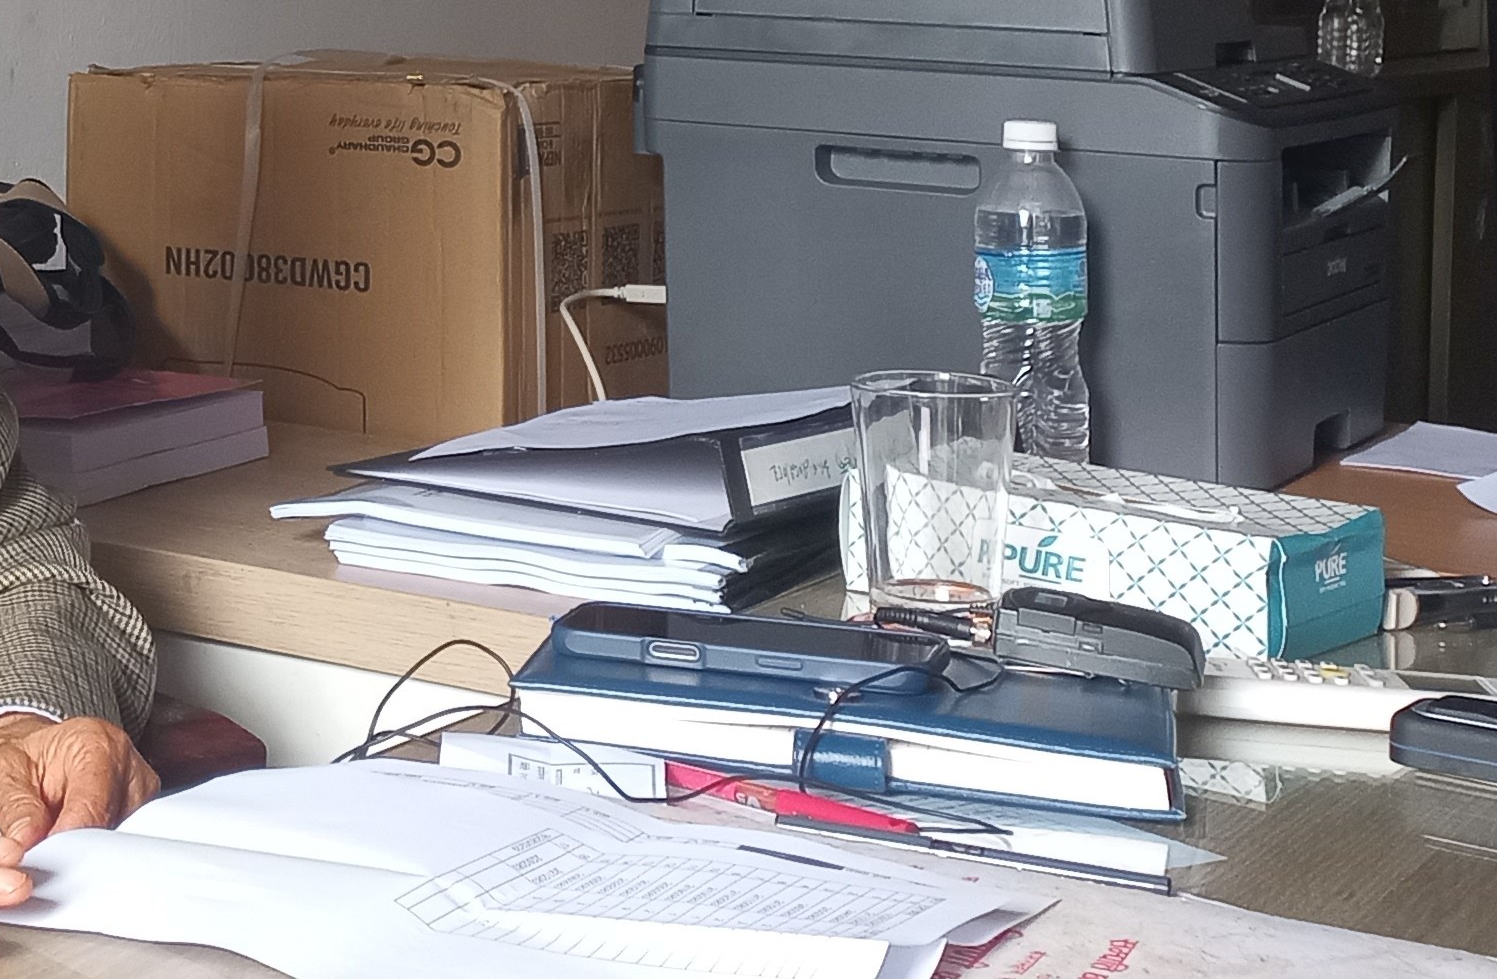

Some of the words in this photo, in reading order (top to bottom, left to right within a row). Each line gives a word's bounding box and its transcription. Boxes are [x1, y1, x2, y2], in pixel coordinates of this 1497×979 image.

[329, 113, 382, 129] everyday
[384, 118, 406, 133] life
[409, 117, 461, 136] Touching
[368, 134, 410, 145] GROUP
[410, 138, 461, 169] CG
[1003, 541, 1087, 583] PURE
[1315, 552, 1348, 583] PURE
